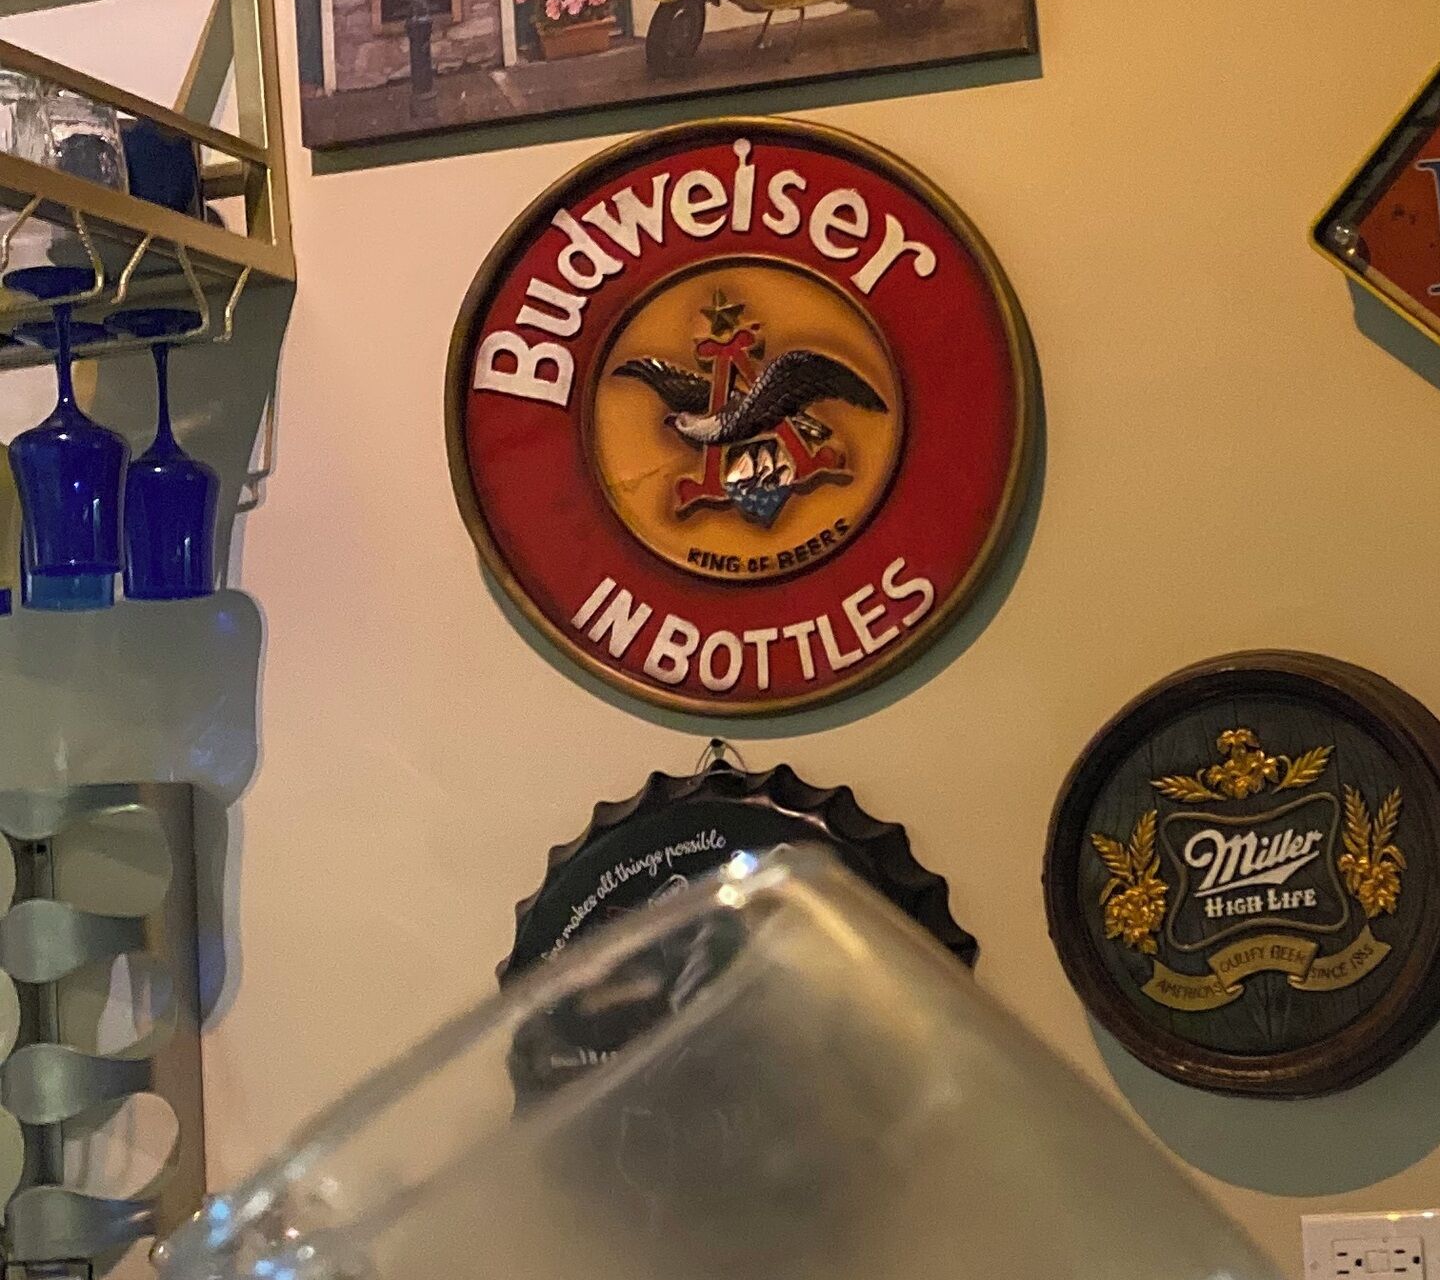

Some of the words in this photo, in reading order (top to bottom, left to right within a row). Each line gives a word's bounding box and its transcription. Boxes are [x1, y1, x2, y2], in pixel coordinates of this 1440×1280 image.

[473, 139, 937, 408] Budweiser
[687, 547, 744, 574] KING
[778, 518, 849, 570] BEERS
[571, 576, 650, 658] IN
[643, 556, 936, 692] BOTTLES
[562, 895, 598, 939] makes
[596, 870, 618, 900] all
[614, 852, 663, 883] things
[665, 829, 726, 867] possible
[1184, 827, 1323, 890] Miller
[1204, 893, 1264, 919] HIGH
[1266, 887, 1317, 911] LIFE
